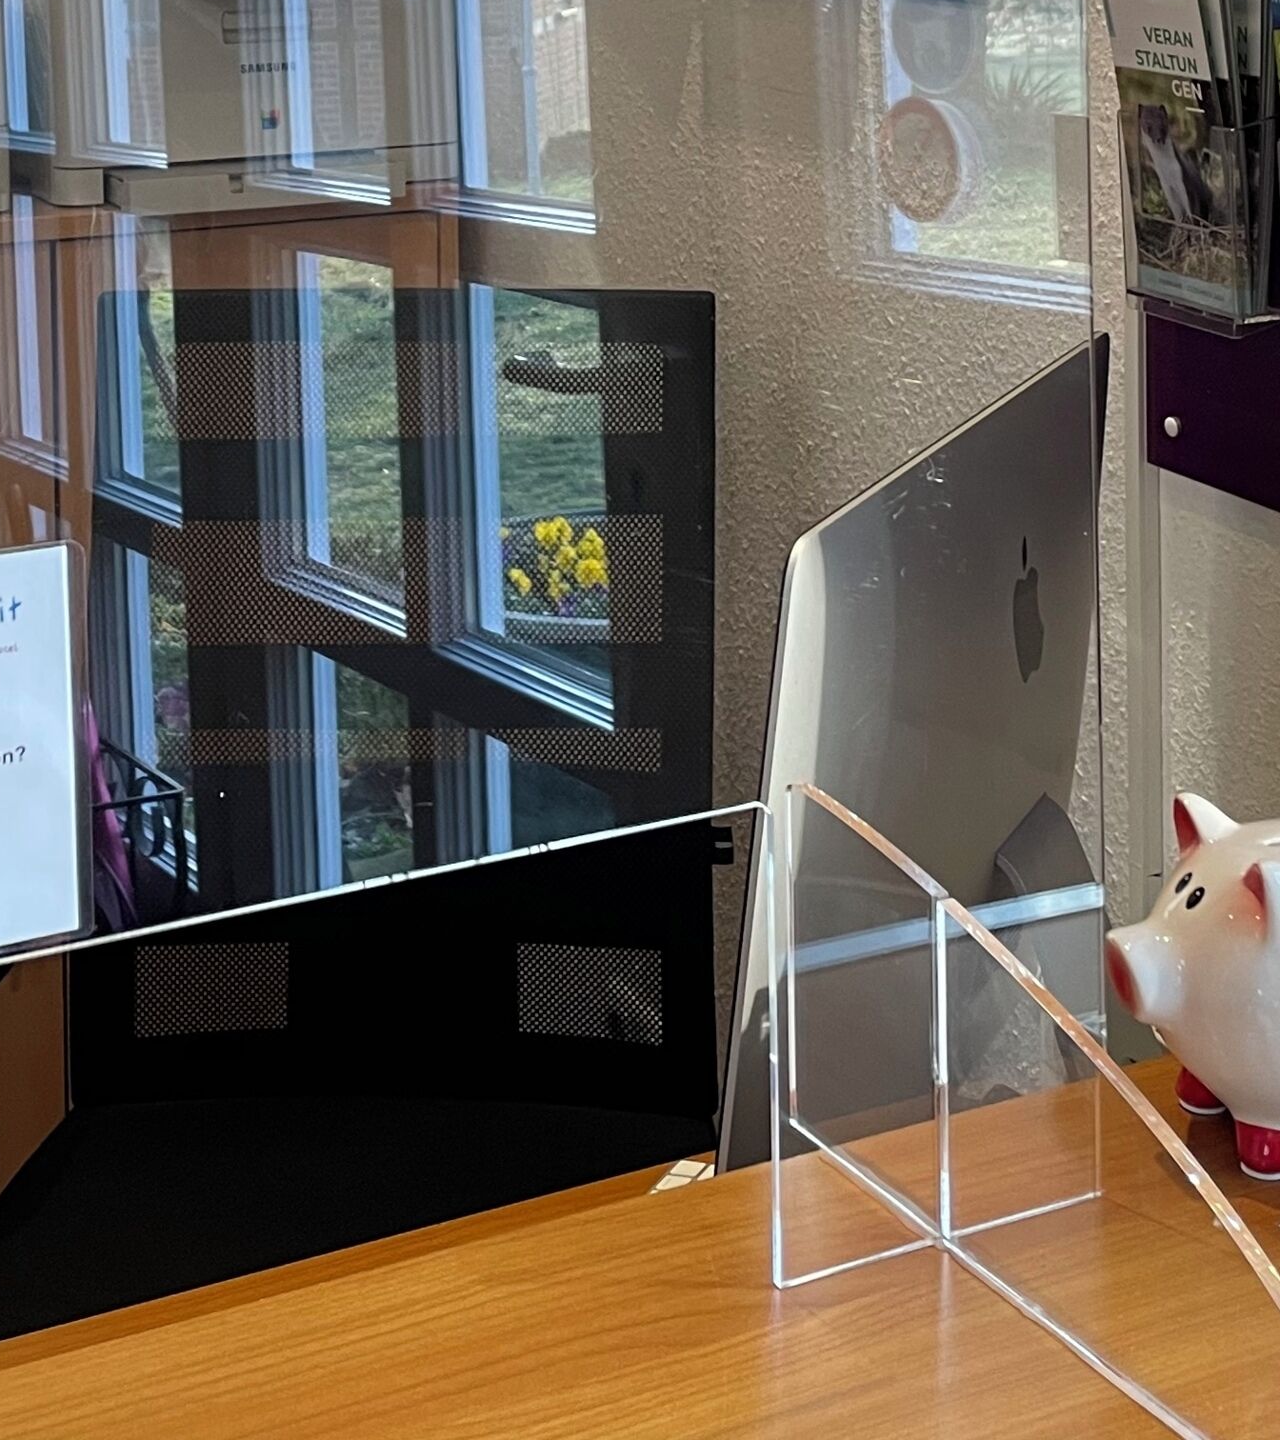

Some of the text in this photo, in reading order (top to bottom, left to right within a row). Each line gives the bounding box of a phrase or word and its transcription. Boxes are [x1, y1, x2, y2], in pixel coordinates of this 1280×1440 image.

[1143, 26, 1194, 48] VERAN
[1135, 49, 1198, 74] STALTUN
[1171, 80, 1203, 101] GEN
